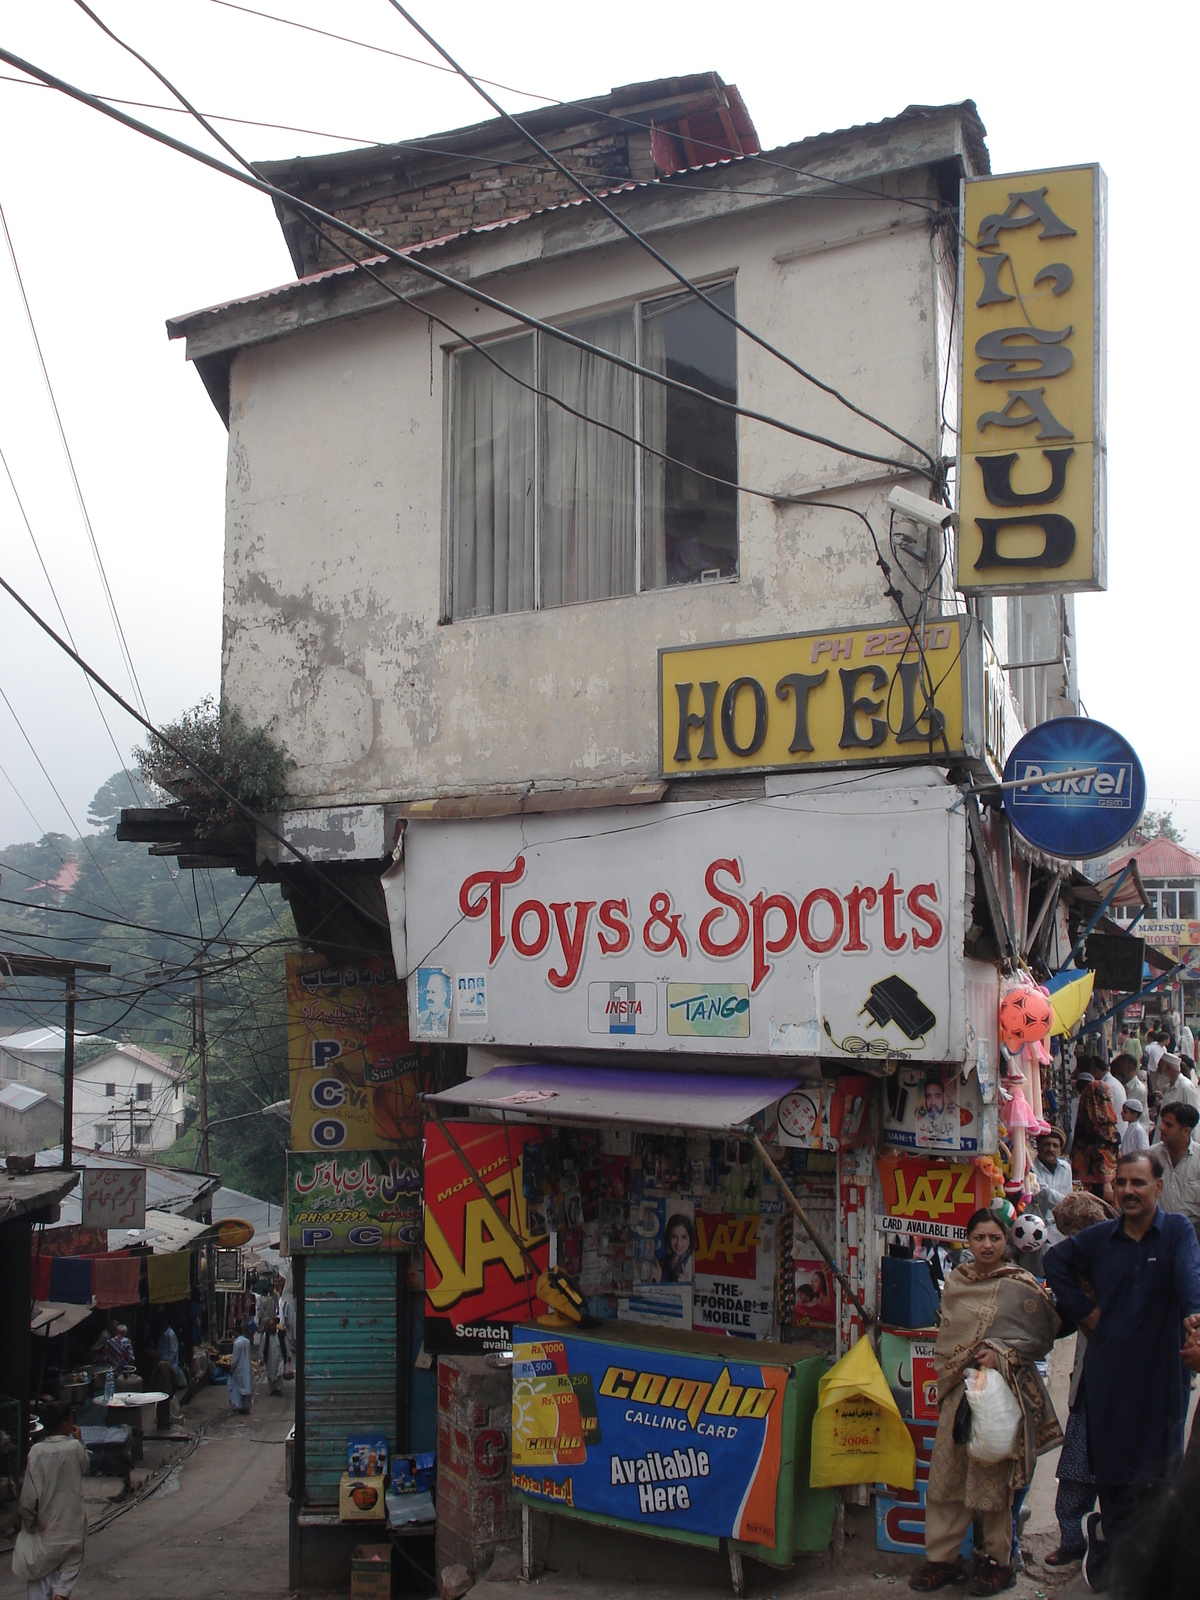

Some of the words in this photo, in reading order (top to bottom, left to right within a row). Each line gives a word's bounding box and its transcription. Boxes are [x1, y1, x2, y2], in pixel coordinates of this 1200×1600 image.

[811, 636, 853, 663] PH
[672, 662, 946, 763] HOTEL
[458, 855, 632, 988] Toys
[642, 891, 688, 959] &
[699, 857, 944, 992] Sports
[1138, 924, 1186, 933] MAJESTIC
[1146, 935, 1179, 943] HOTEL
[605, 999, 643, 1015] INSTA
[669, 993, 750, 1023] TANGO
[371, 1067, 394, 1081] Sun
[437, 1154, 510, 1203] Moblink
[890, 1163, 976, 1220] JAZZ
[297, 1210, 368, 1223] PH:412799
[882, 1217, 903, 1231] CARD
[906, 1220, 949, 1238] AVAILABLE
[694, 1214, 762, 1264] JAZZ
[713, 1282, 739, 1297] THE
[455, 1323, 510, 1340] Scratch
[702, 1309, 751, 1327] MOBILE
[624, 1409, 687, 1432] CALLING
[696, 1422, 739, 1439] CARD
[610, 1447, 710, 1485] Available
[637, 1483, 691, 1514] Here
